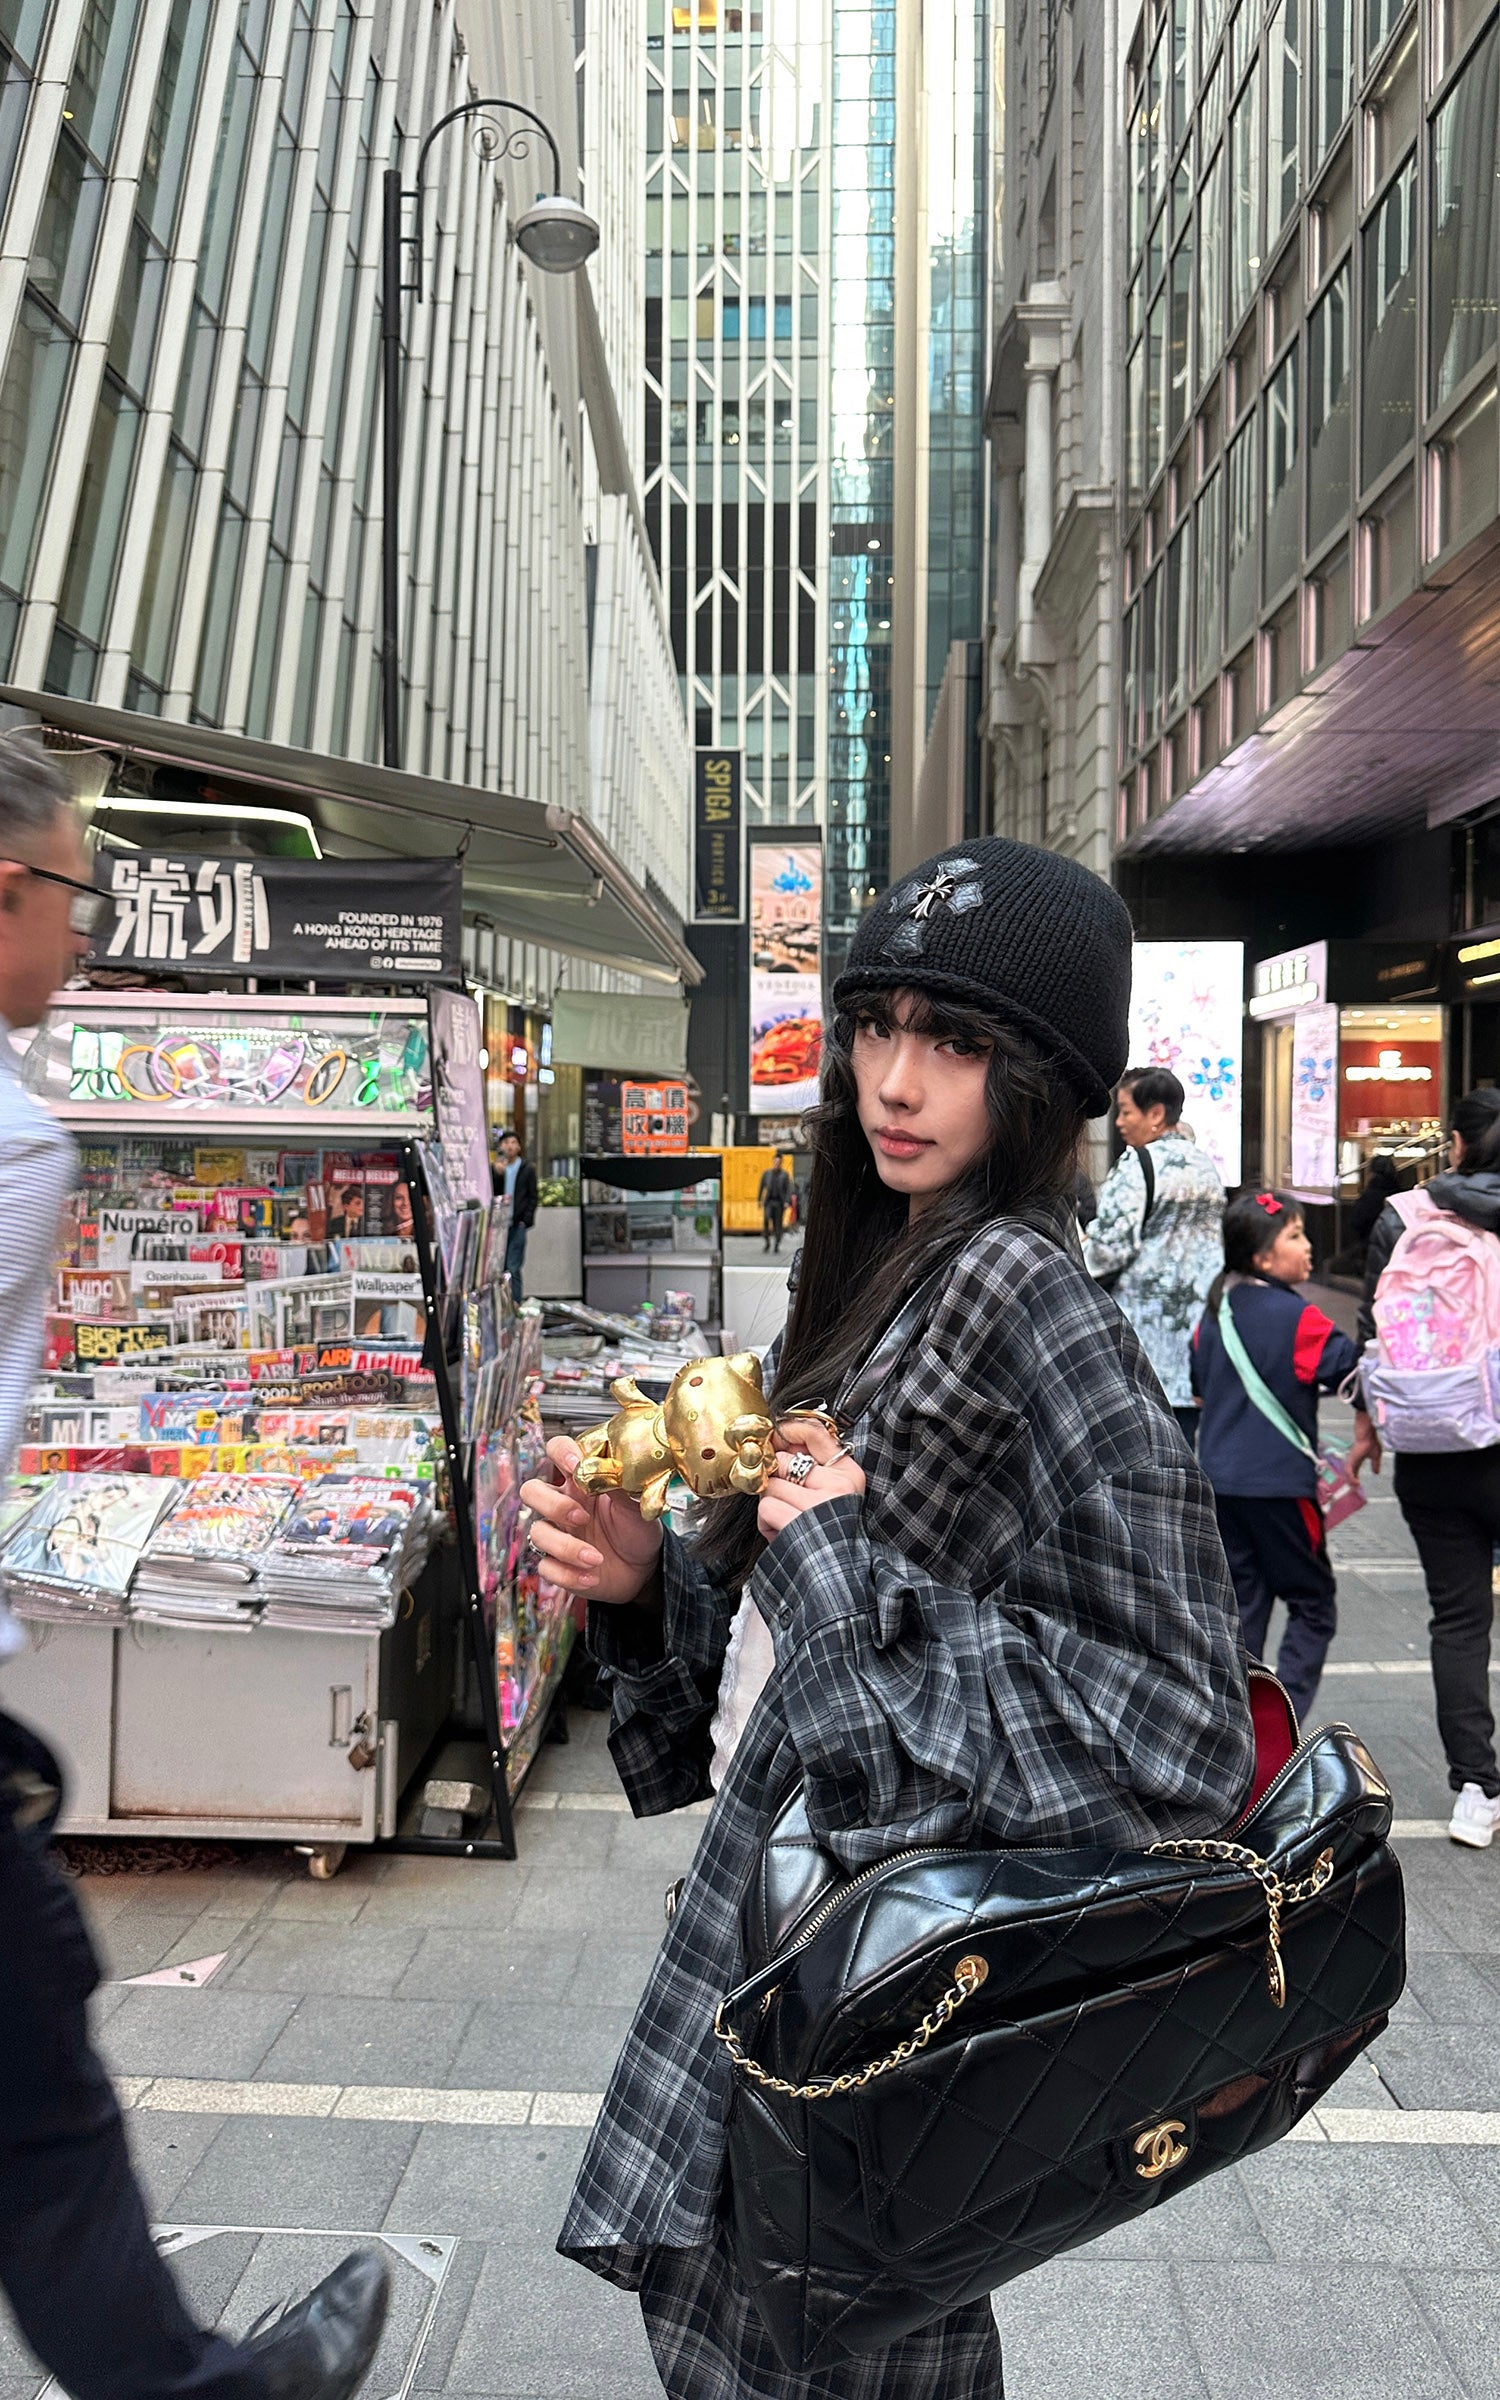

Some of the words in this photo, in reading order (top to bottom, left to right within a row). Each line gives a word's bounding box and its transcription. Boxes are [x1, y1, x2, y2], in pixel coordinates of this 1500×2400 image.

[704, 758, 732, 822] SPIGA
[338, 911, 399, 926] FOUNDED
[401, 913, 415, 927] IN
[417, 914, 444, 928] 1976
[292, 922, 303, 935] A
[304, 923, 343, 937] HONG
[343, 925, 381, 938] KONG
[382, 926, 443, 941] HERITAGE
[325, 937, 370, 951] AHEAD
[370, 938, 389, 951] OF
[390, 939, 410, 952] ITS
[412, 940, 443, 953] TIME
[103, 1212, 193, 1235] Numéro
[146, 1269, 208, 1282] Openhouse
[77, 1325, 150, 1343] SIGHT
[77, 1340, 168, 1360] SOUND
